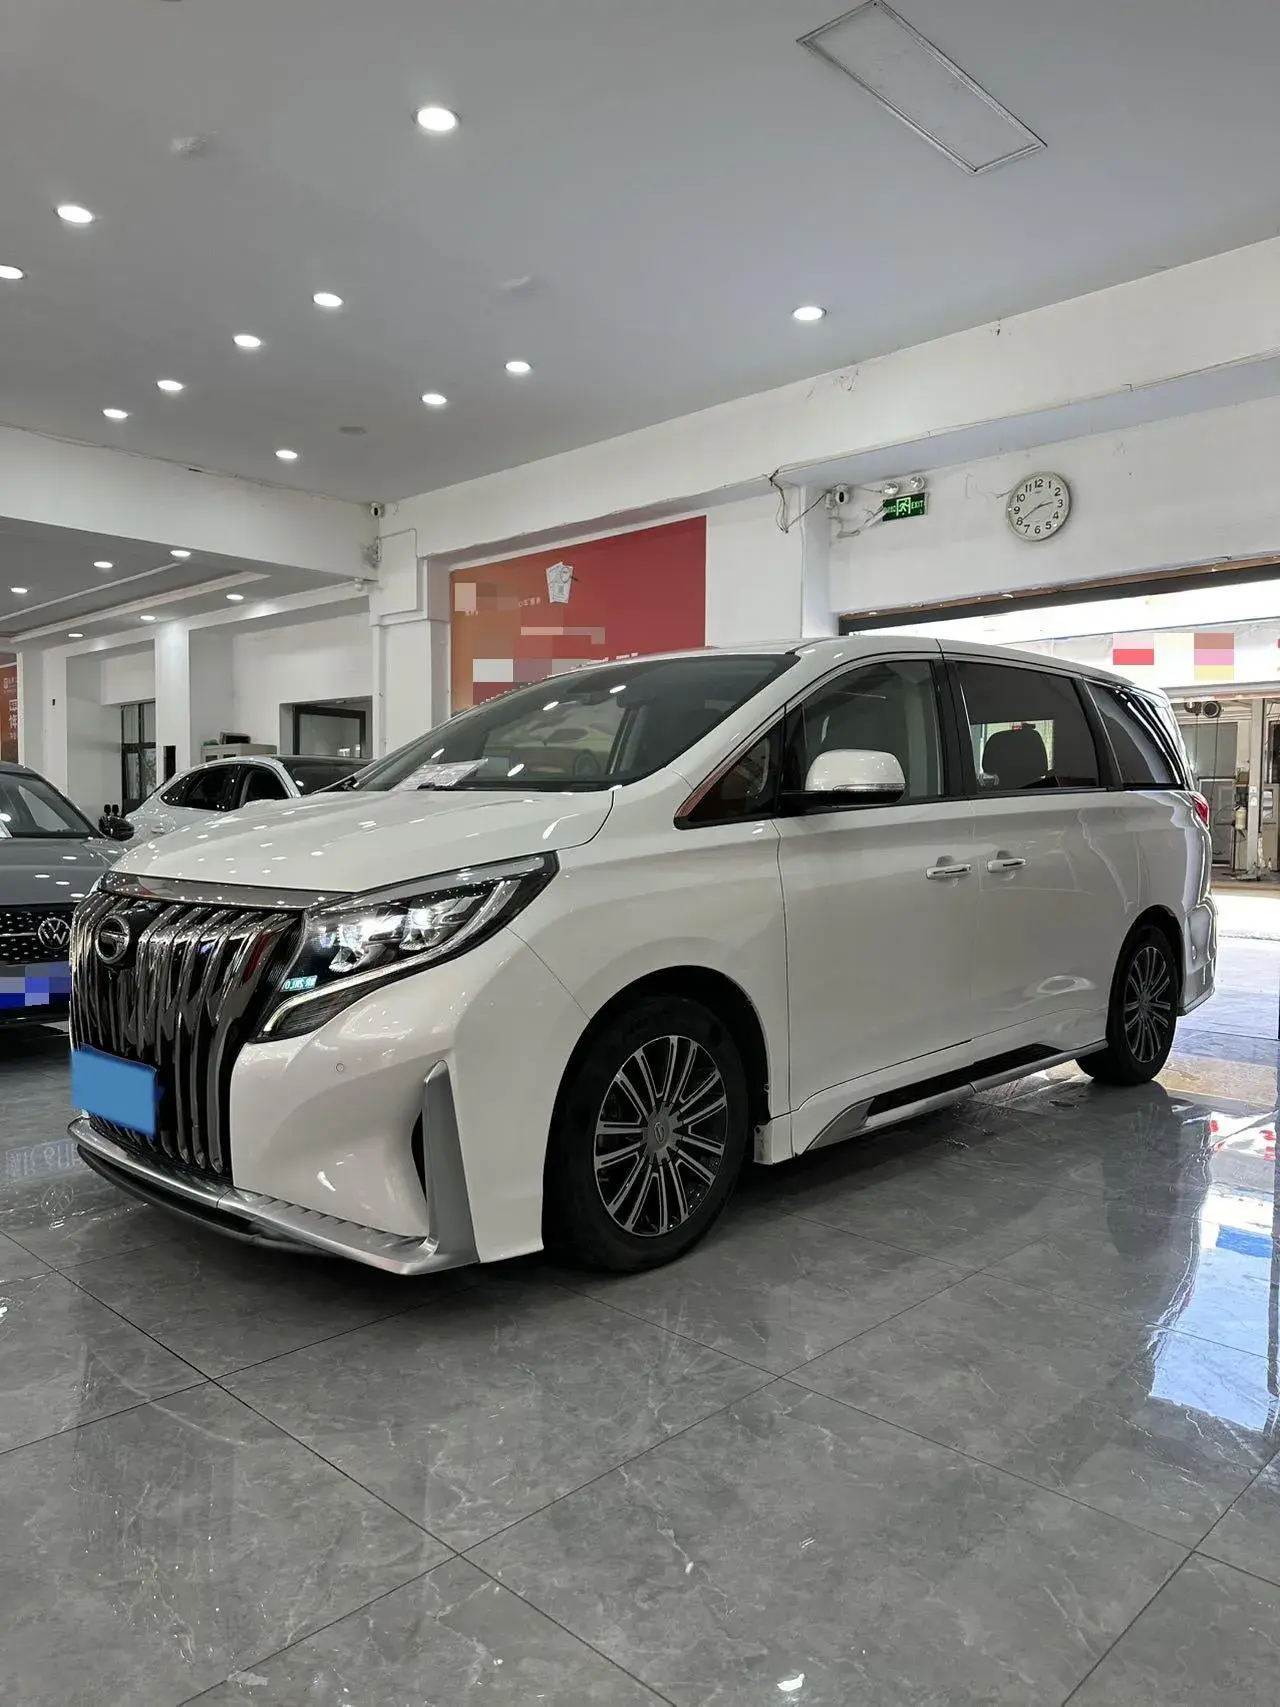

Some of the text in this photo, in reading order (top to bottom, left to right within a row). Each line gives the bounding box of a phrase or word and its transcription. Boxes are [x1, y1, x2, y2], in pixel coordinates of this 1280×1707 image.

[1034, 478, 1044, 488] 12
[1025, 483, 1032, 493] 11
[1054, 487, 1061, 497] 2
[1016, 493, 1026, 503] 10
[911, 500, 924, 509] EXIT
[1057, 499, 1064, 508] 3
[1013, 506, 1021, 515] 9
[1053, 511, 1059, 519] 4
[1016, 517, 1023, 526] 8
[1045, 521, 1052, 530] 5
[1024, 524, 1031, 533] 7
[1034, 525, 1041, 534] 6
